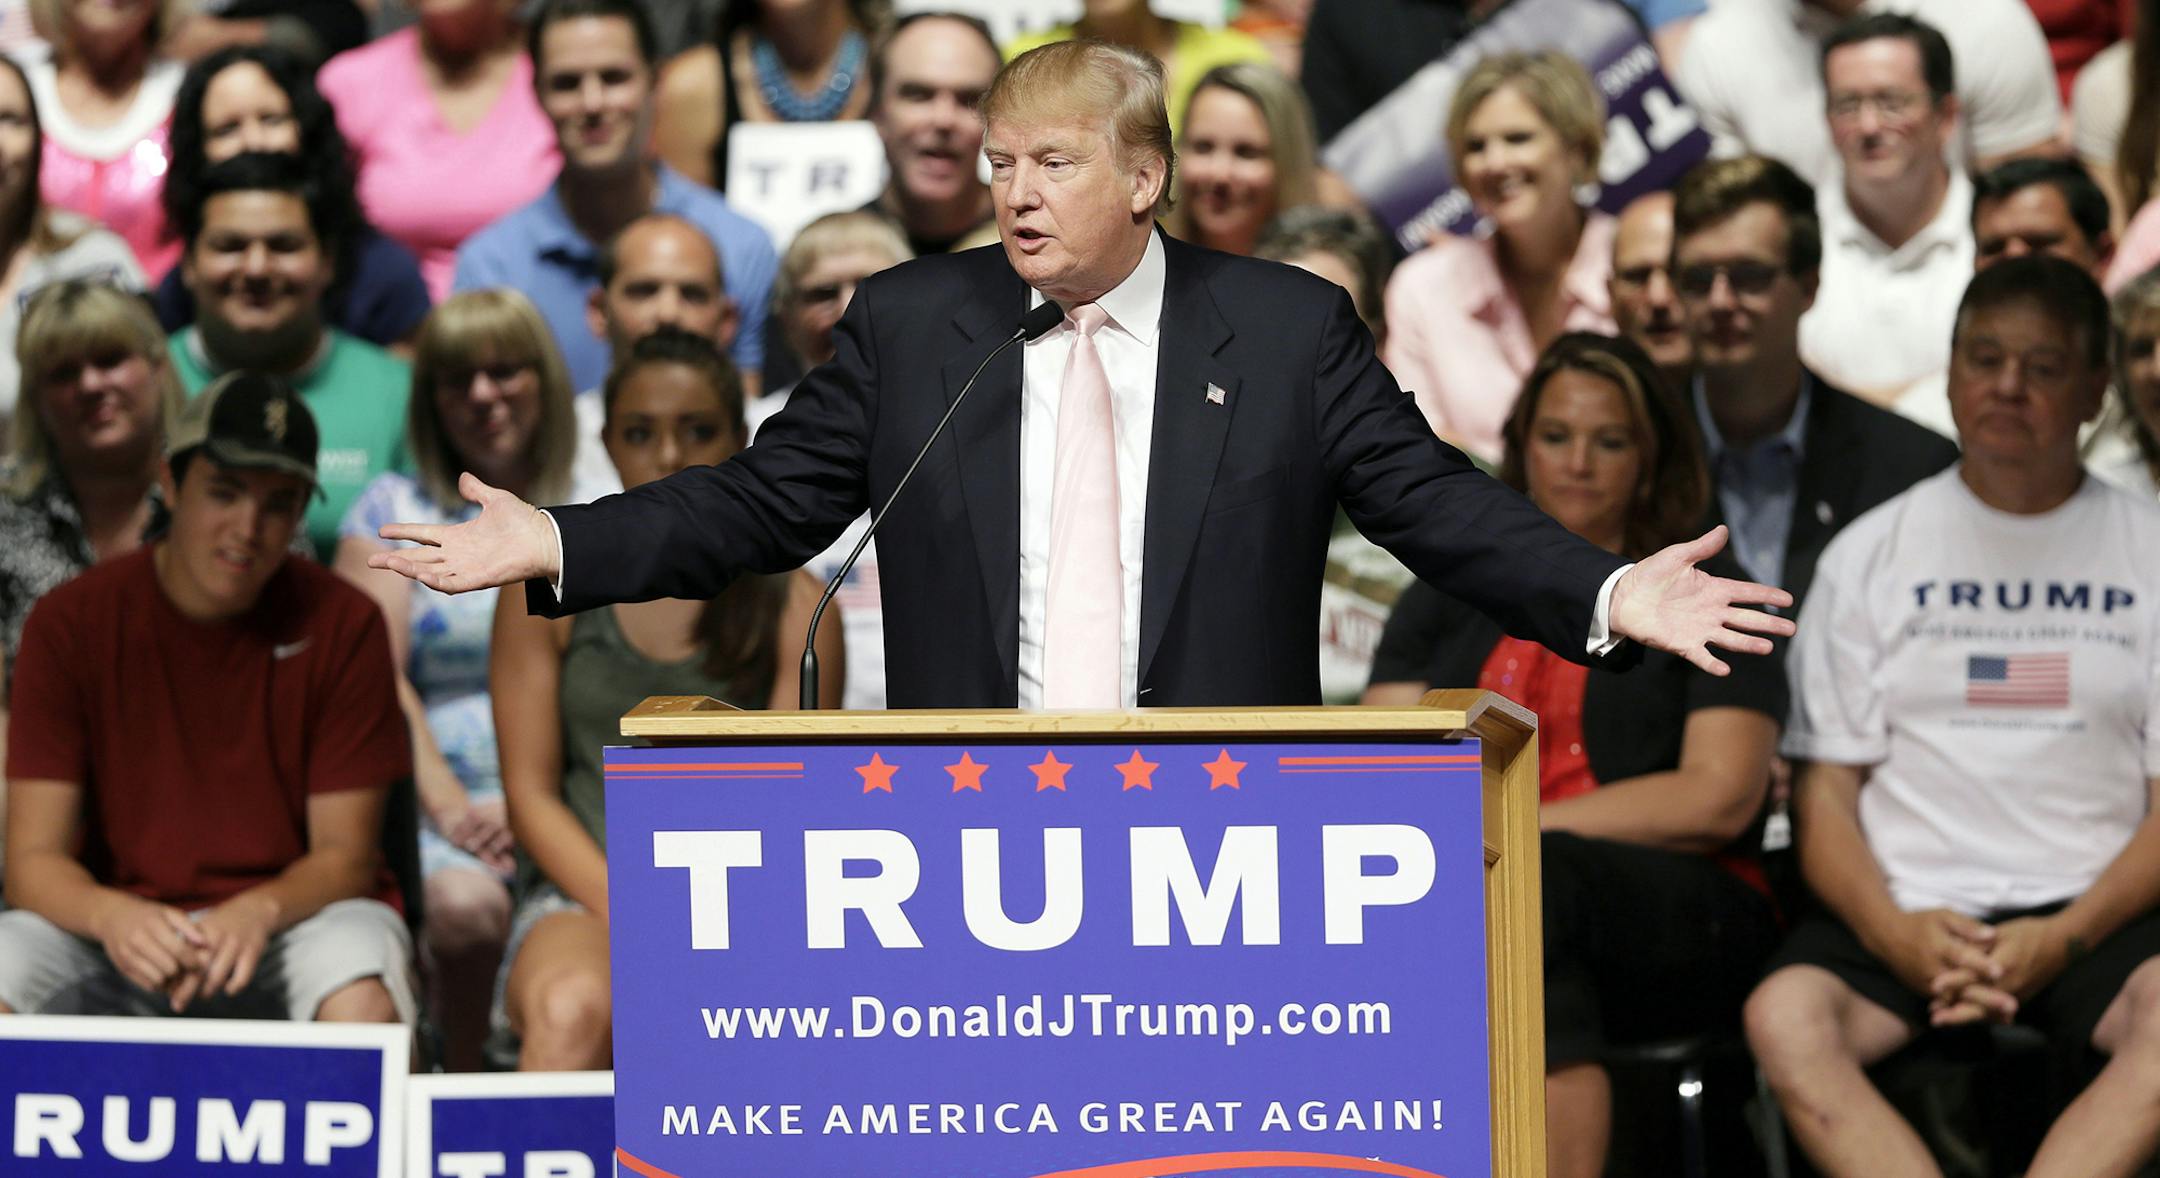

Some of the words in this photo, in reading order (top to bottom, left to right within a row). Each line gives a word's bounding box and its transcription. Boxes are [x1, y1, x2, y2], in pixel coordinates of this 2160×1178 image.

[1913, 580, 2136, 614] TRUMP
[652, 824, 1436, 951] TRUMP
[701, 994, 1392, 1045] www.DonaldJTrump.com
[13, 1094, 374, 1165] RUMP
[662, 1104, 803, 1135] MAKE
[822, 1102, 1058, 1135] AMERICA
[1079, 1101, 1243, 1133] GREAT
[1260, 1100, 1443, 1132] AGAIN!
